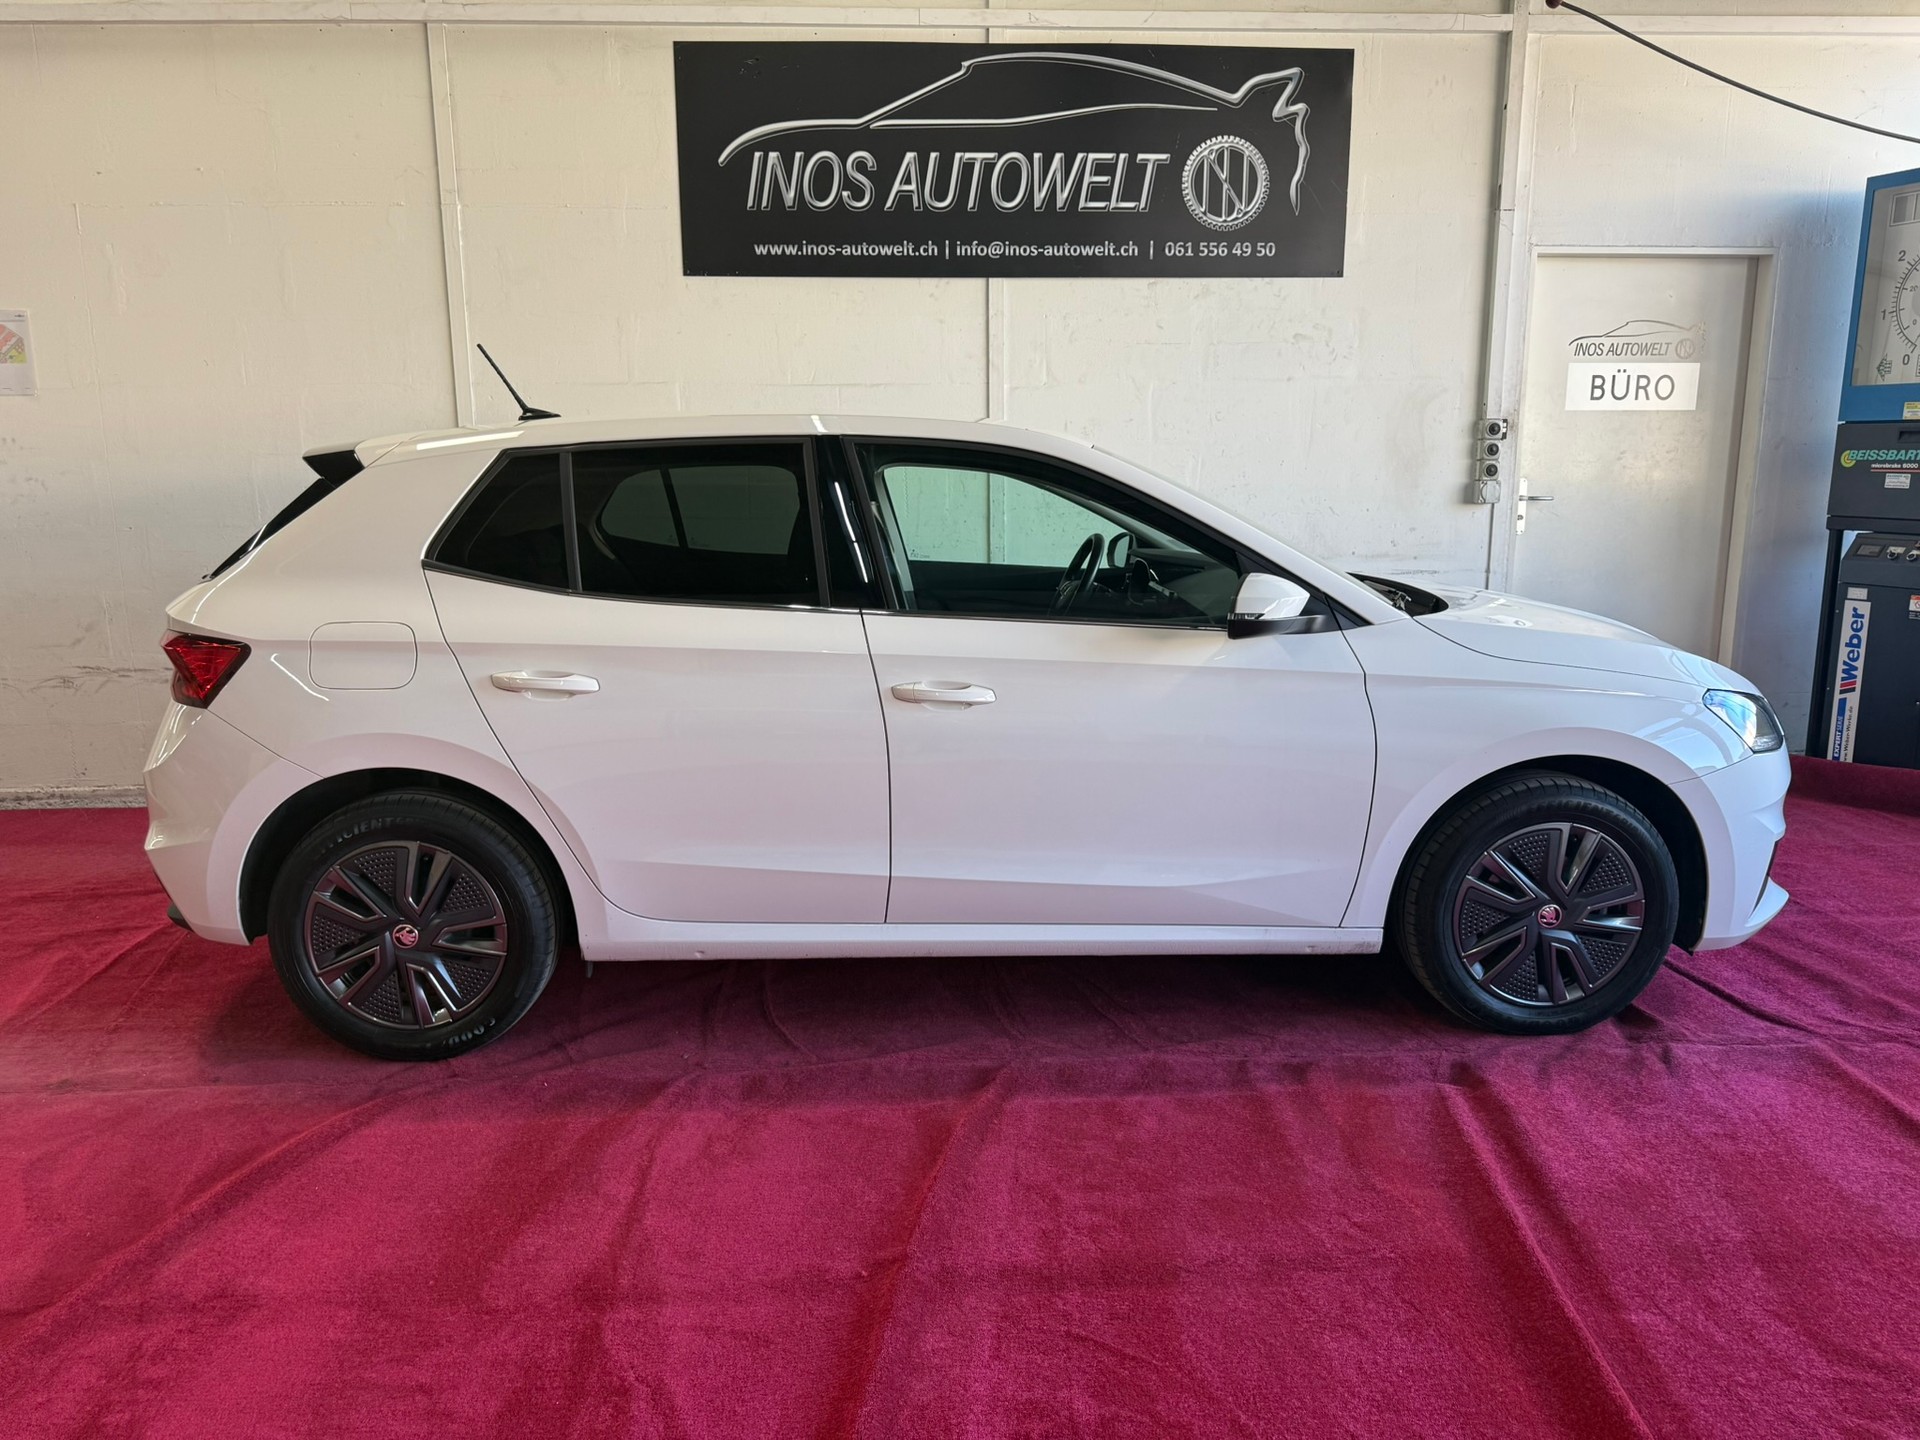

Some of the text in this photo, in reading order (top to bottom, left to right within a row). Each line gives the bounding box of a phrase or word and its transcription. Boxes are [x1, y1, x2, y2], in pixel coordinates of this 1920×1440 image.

[747, 150, 877, 212] INOS
[884, 150, 1170, 213] AUTOWELT
[754, 239, 1276, 259] www.inos-autowelt.ch info@inos-autowelt.ch 061 556 49 50
[1898, 249, 1907, 262] 2
[1880, 308, 1887, 321] 1
[1573, 342, 1605, 357] INOS
[1605, 342, 1673, 357] AUTOWELT
[1902, 353, 1911, 366] 0
[1589, 368, 1675, 401] BÜRO
[1841, 606, 1865, 682] Weber
[1833, 730, 1842, 758] EXPERT
